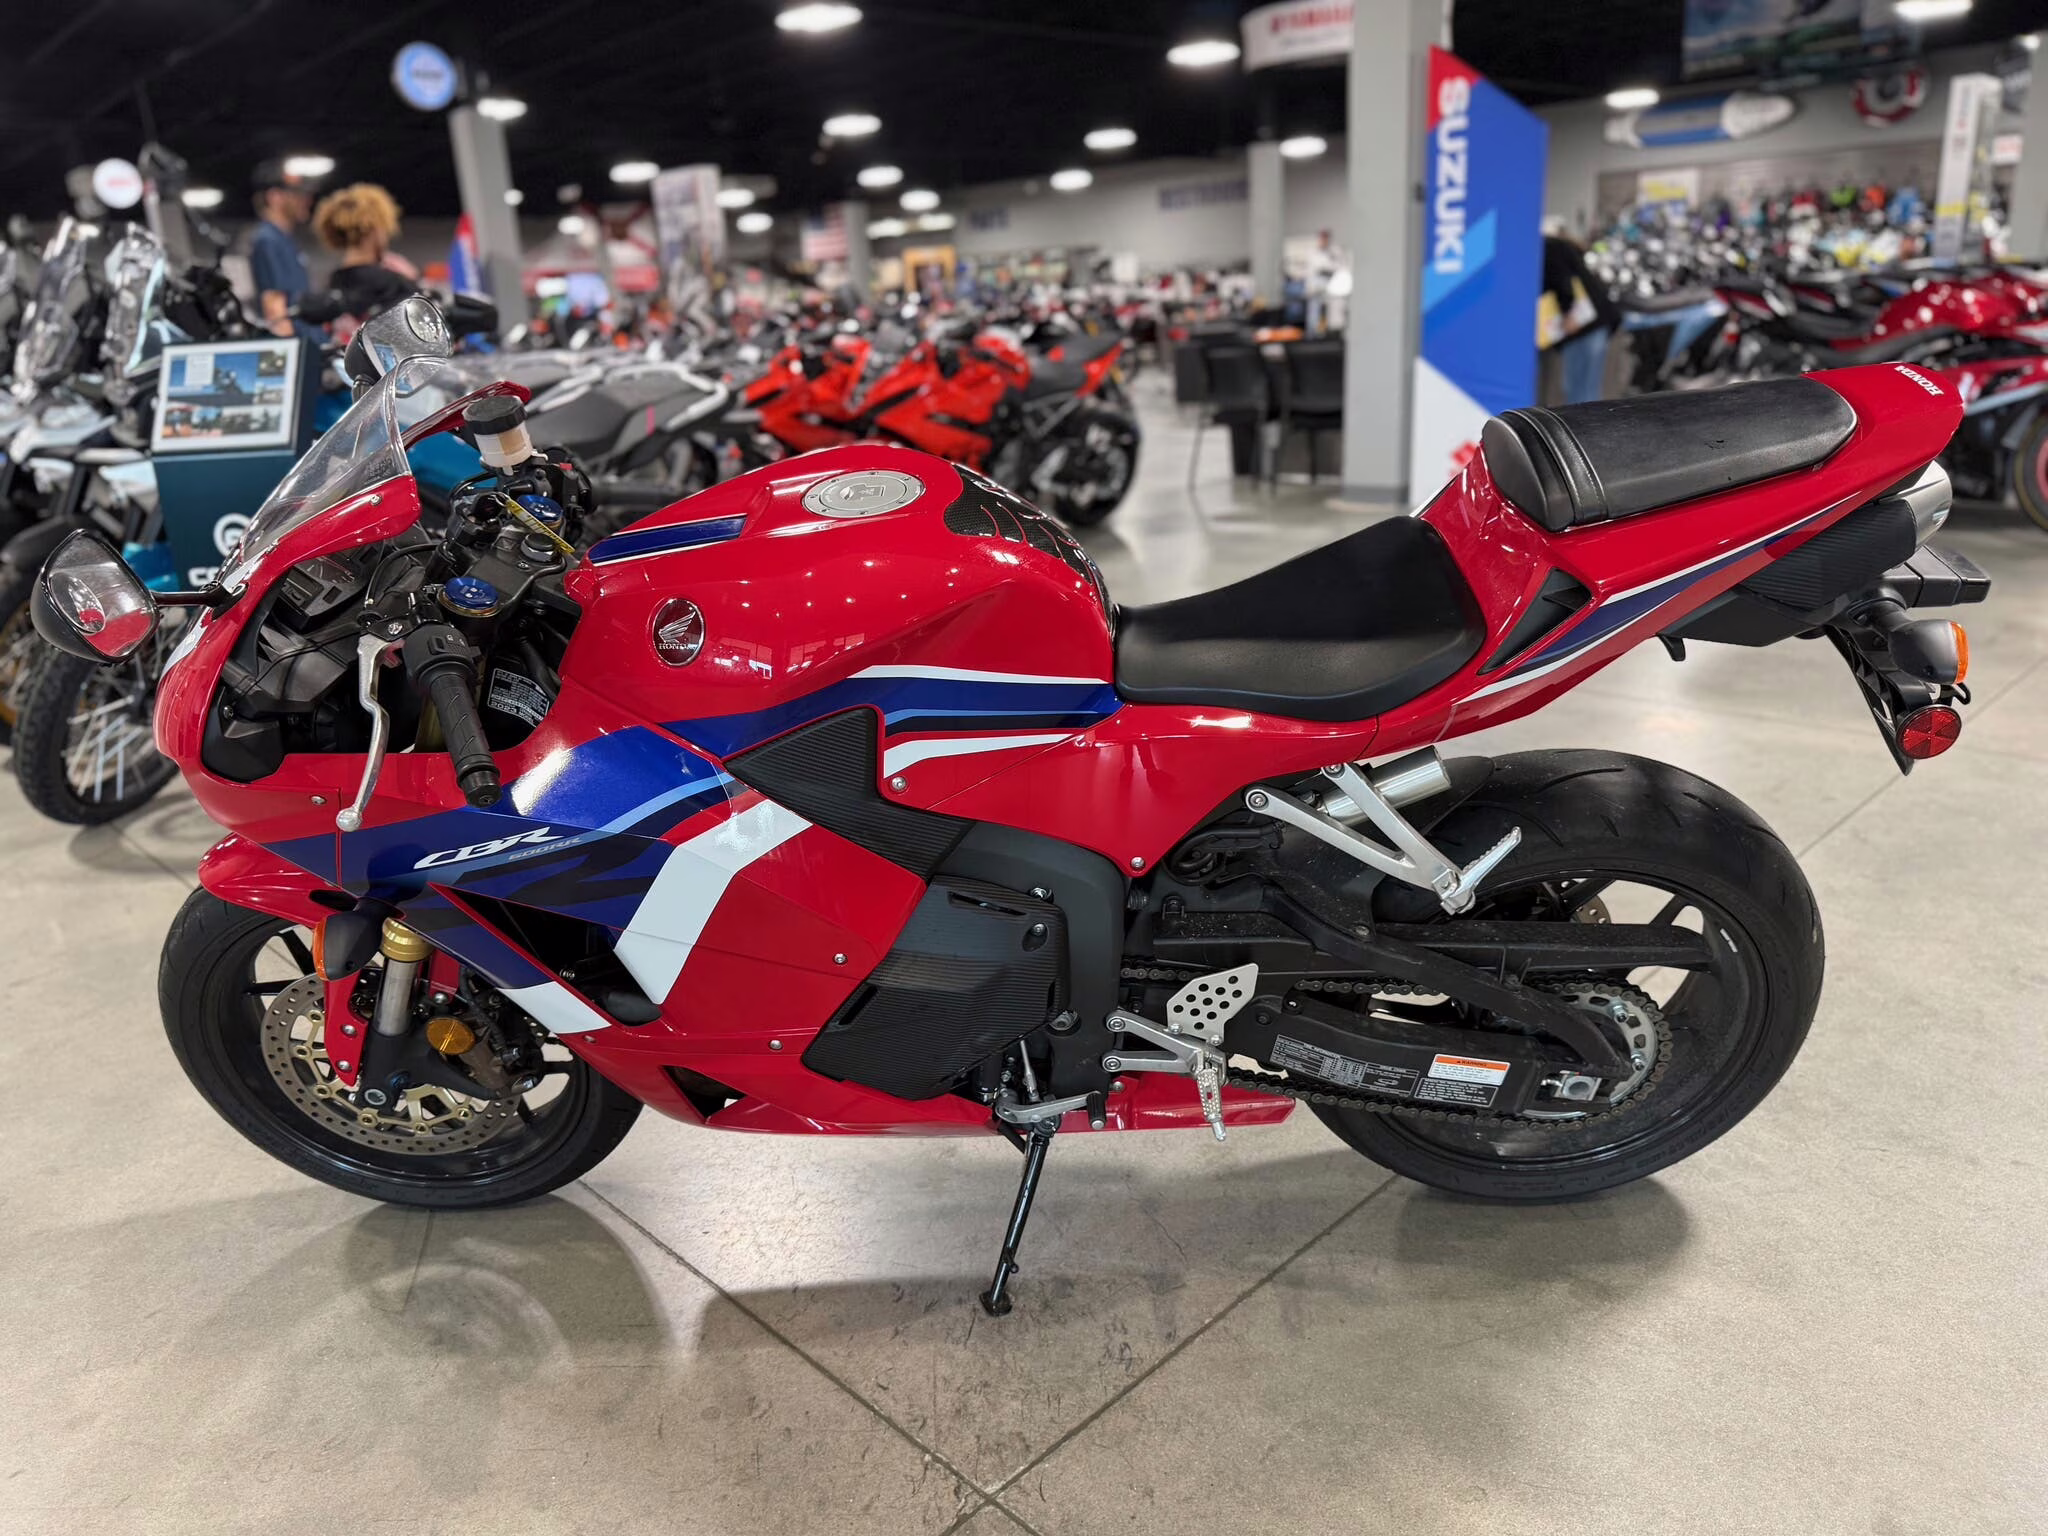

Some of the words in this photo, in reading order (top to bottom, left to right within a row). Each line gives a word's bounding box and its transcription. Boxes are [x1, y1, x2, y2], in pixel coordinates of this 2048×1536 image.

[1434, 75, 1471, 274] SUZUKI
[1894, 365, 1945, 396] HONDA
[413, 826, 565, 870] CBR
[508, 837, 582, 861] 600RR
